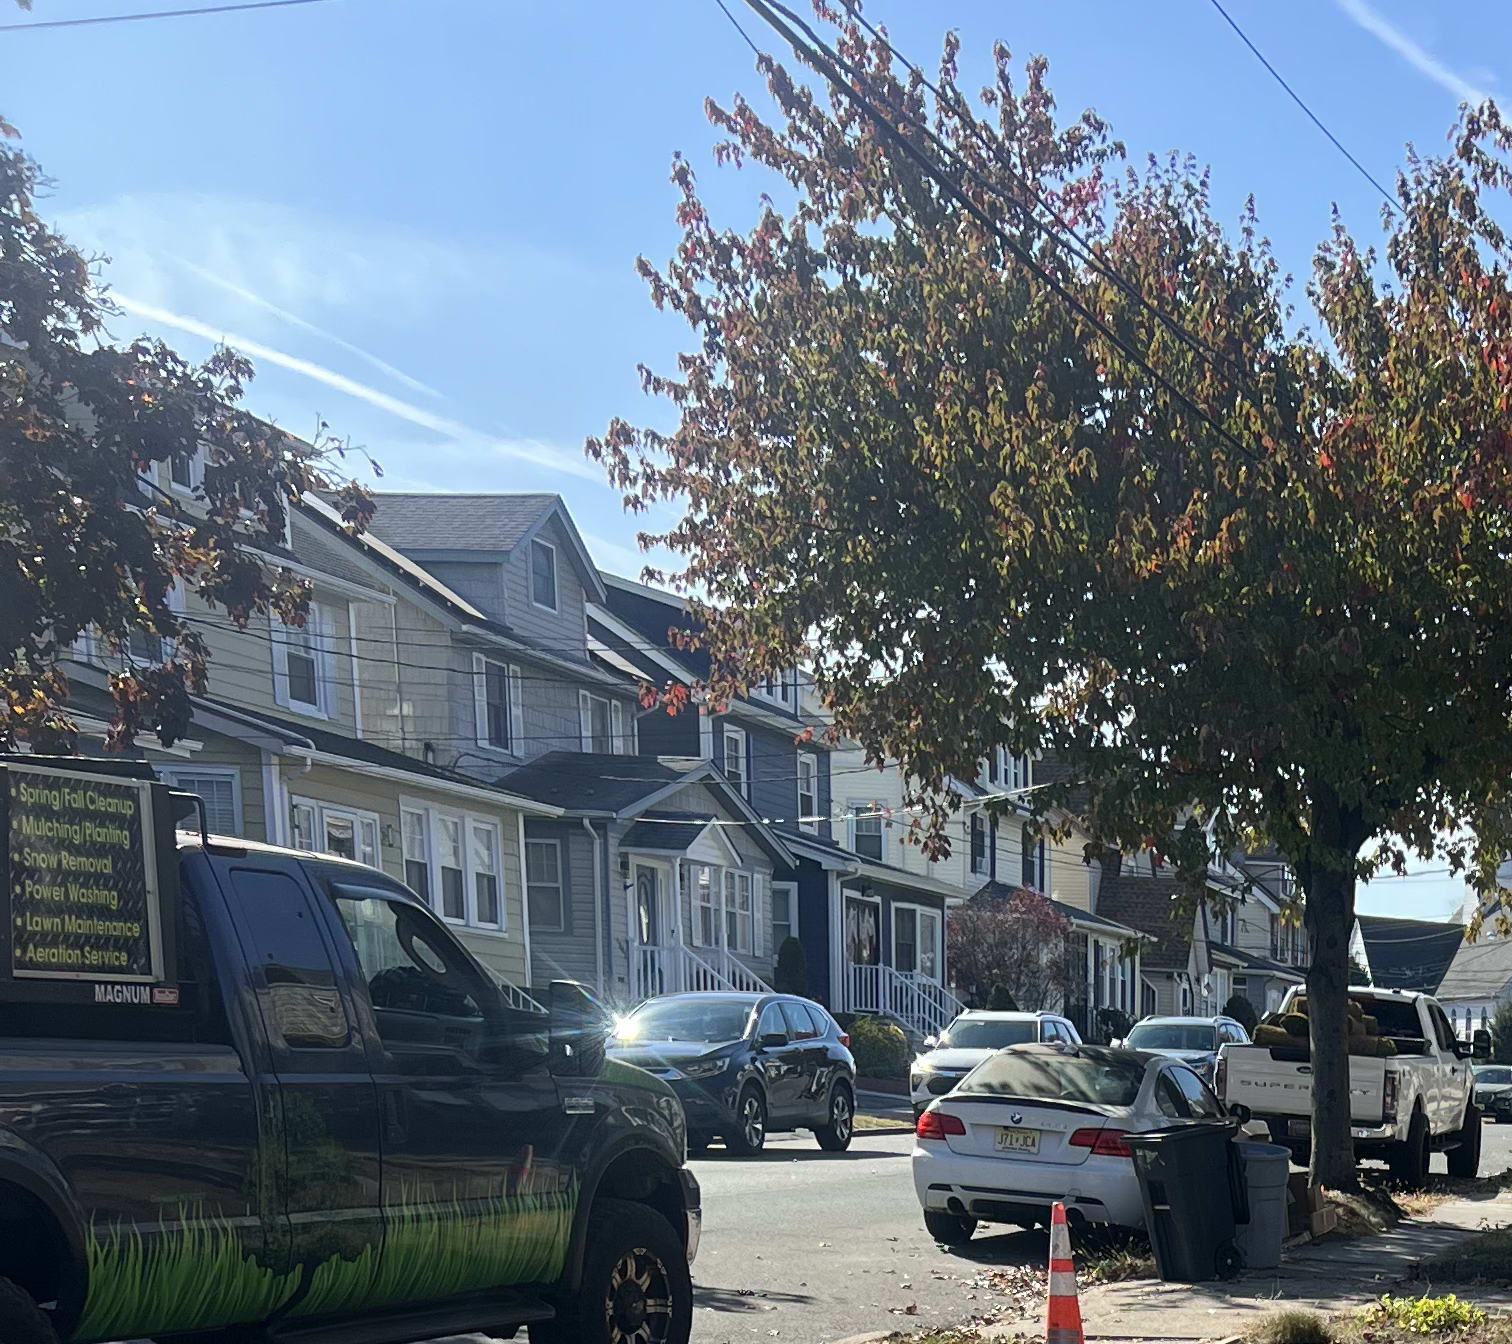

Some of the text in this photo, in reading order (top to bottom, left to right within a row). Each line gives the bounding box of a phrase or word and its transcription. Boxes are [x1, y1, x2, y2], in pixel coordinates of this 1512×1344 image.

[20, 783, 134, 817] Spring/Fall Cleanup
[22, 816, 130, 849] Mulching/Planting
[23, 850, 112, 874] Snow Removal
[25, 880, 118, 910] Power Washing
[26, 912, 140, 937] Lawn Maintenance
[26, 943, 128, 966] Aeration Service
[94, 983, 151, 1004] MAGNUM
